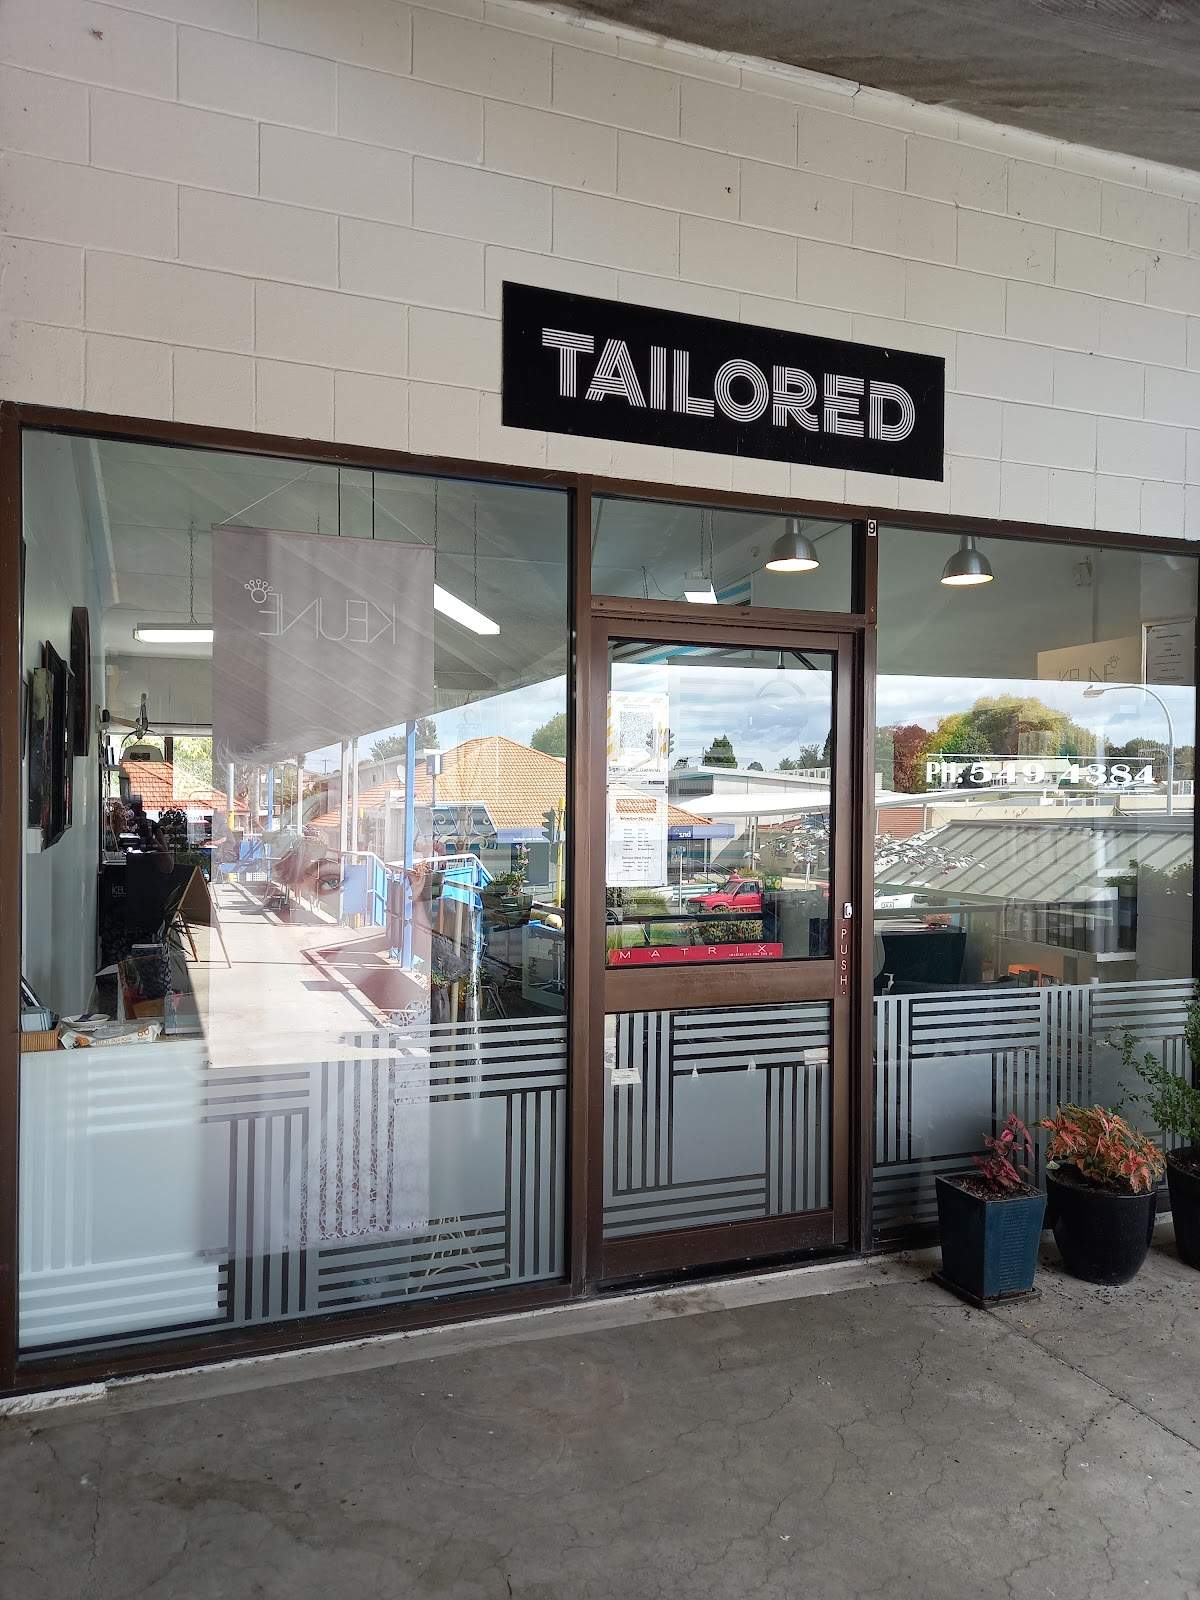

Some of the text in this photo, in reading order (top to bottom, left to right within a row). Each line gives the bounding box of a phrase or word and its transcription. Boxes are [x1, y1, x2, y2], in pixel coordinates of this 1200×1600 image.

[541, 327, 916, 442] TAILORED
[868, 521, 876, 535] 9
[619, 944, 767, 959] MATRIX
[840, 928, 848, 985] PUSH
